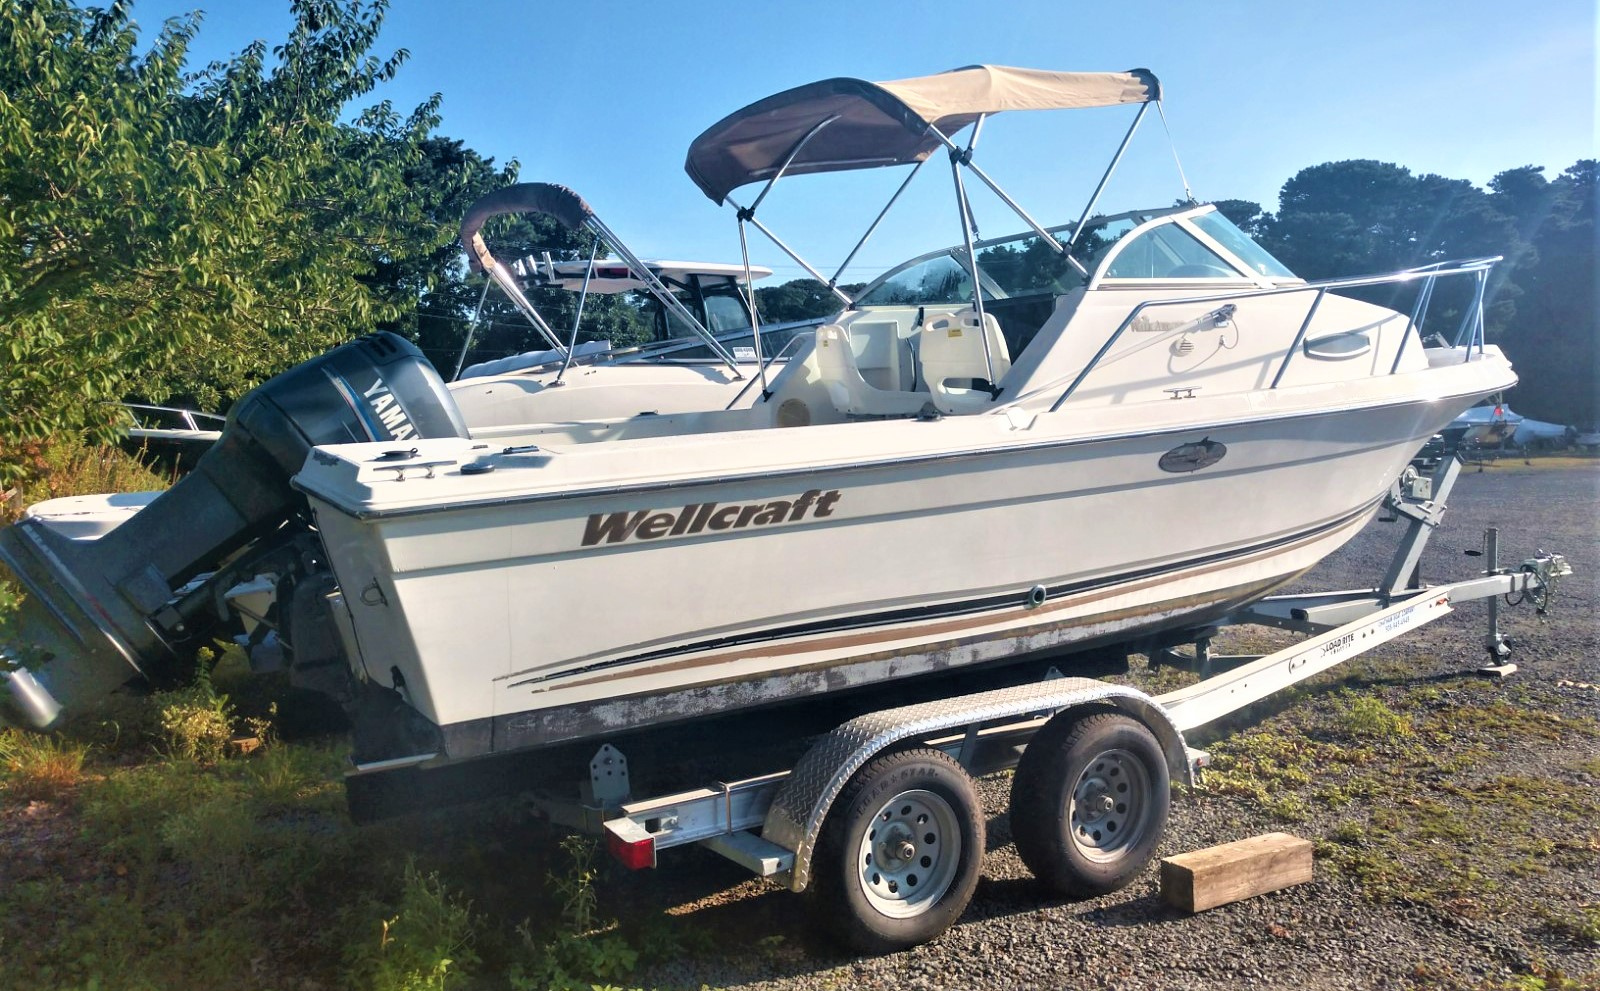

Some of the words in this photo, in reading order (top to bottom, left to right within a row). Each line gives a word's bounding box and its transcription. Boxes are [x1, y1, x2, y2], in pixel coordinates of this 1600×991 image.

[363, 378, 420, 441] YAMA
[580, 488, 842, 547] Wellcraft
[1326, 639, 1341, 651] LOAD
[1343, 633, 1354, 644] RITE
